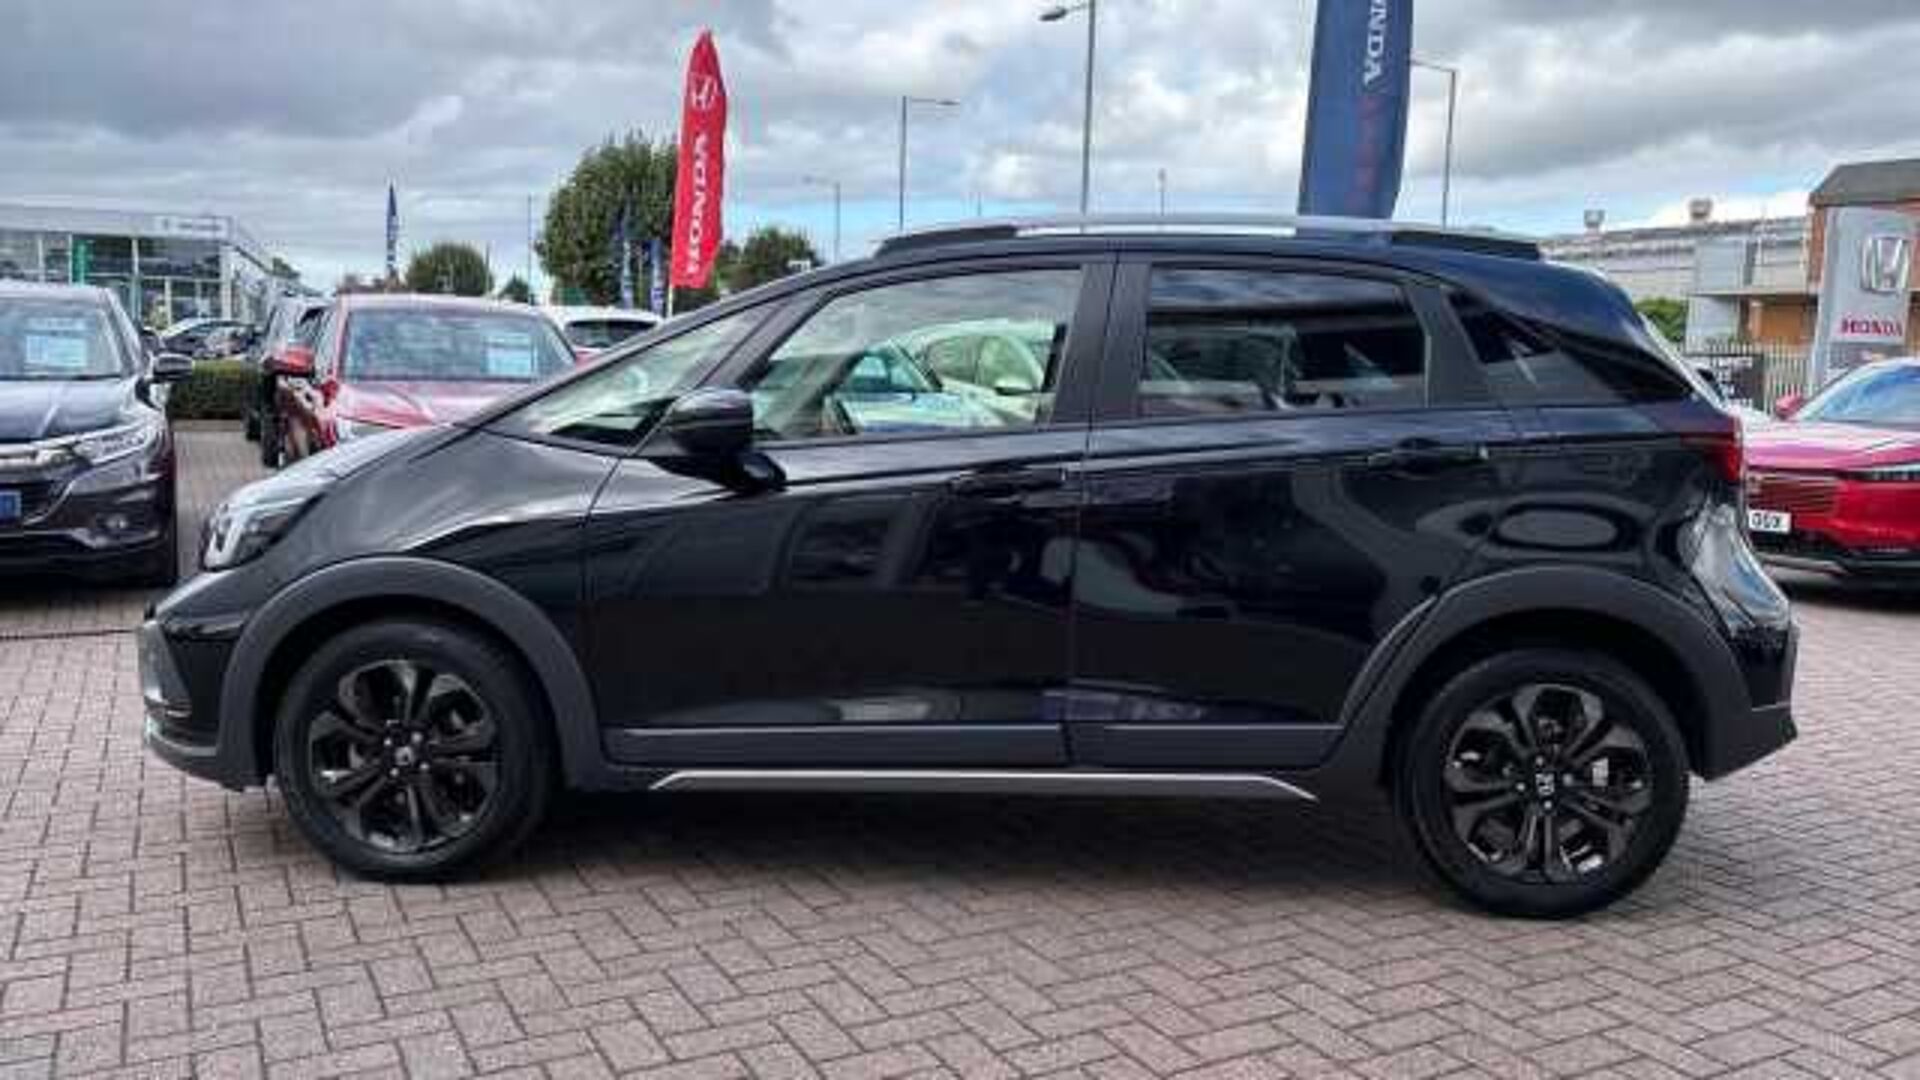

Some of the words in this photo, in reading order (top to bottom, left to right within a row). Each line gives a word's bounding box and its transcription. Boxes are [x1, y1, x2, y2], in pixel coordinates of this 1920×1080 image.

[1363, 0, 1387, 87] NDA
[687, 133, 708, 273] HONDA
[1841, 319, 1903, 336] HONDA
